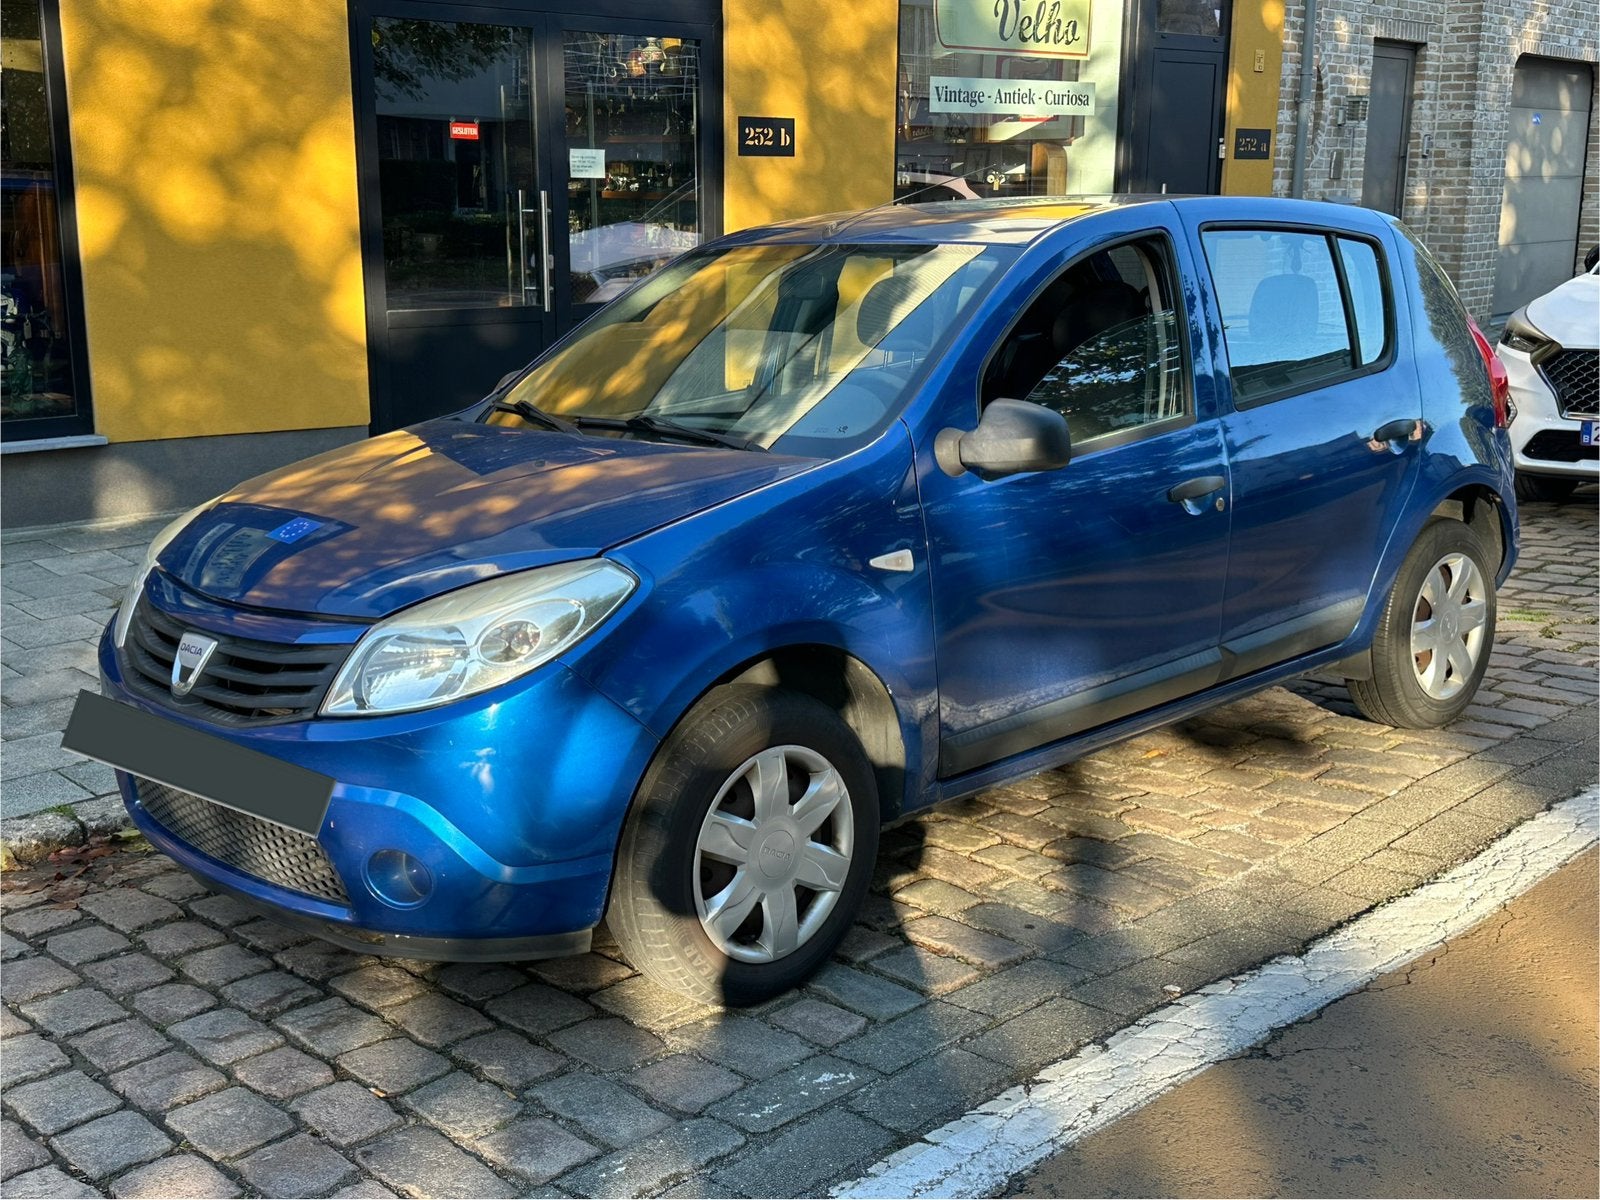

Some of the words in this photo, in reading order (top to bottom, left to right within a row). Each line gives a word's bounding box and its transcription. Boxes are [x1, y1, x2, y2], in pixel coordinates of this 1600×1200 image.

[935, 86, 985, 107] Vintage
[994, 88, 1035, 105] Antiek
[1045, 90, 1089, 106] Curiosa
[745, 127, 774, 146] 252
[780, 127, 791, 146] b
[1239, 137, 1257, 151] 252
[1583, 434, 1590, 443] B
[180, 642, 203, 656] DACIA
[763, 846, 791, 861] DACIA
